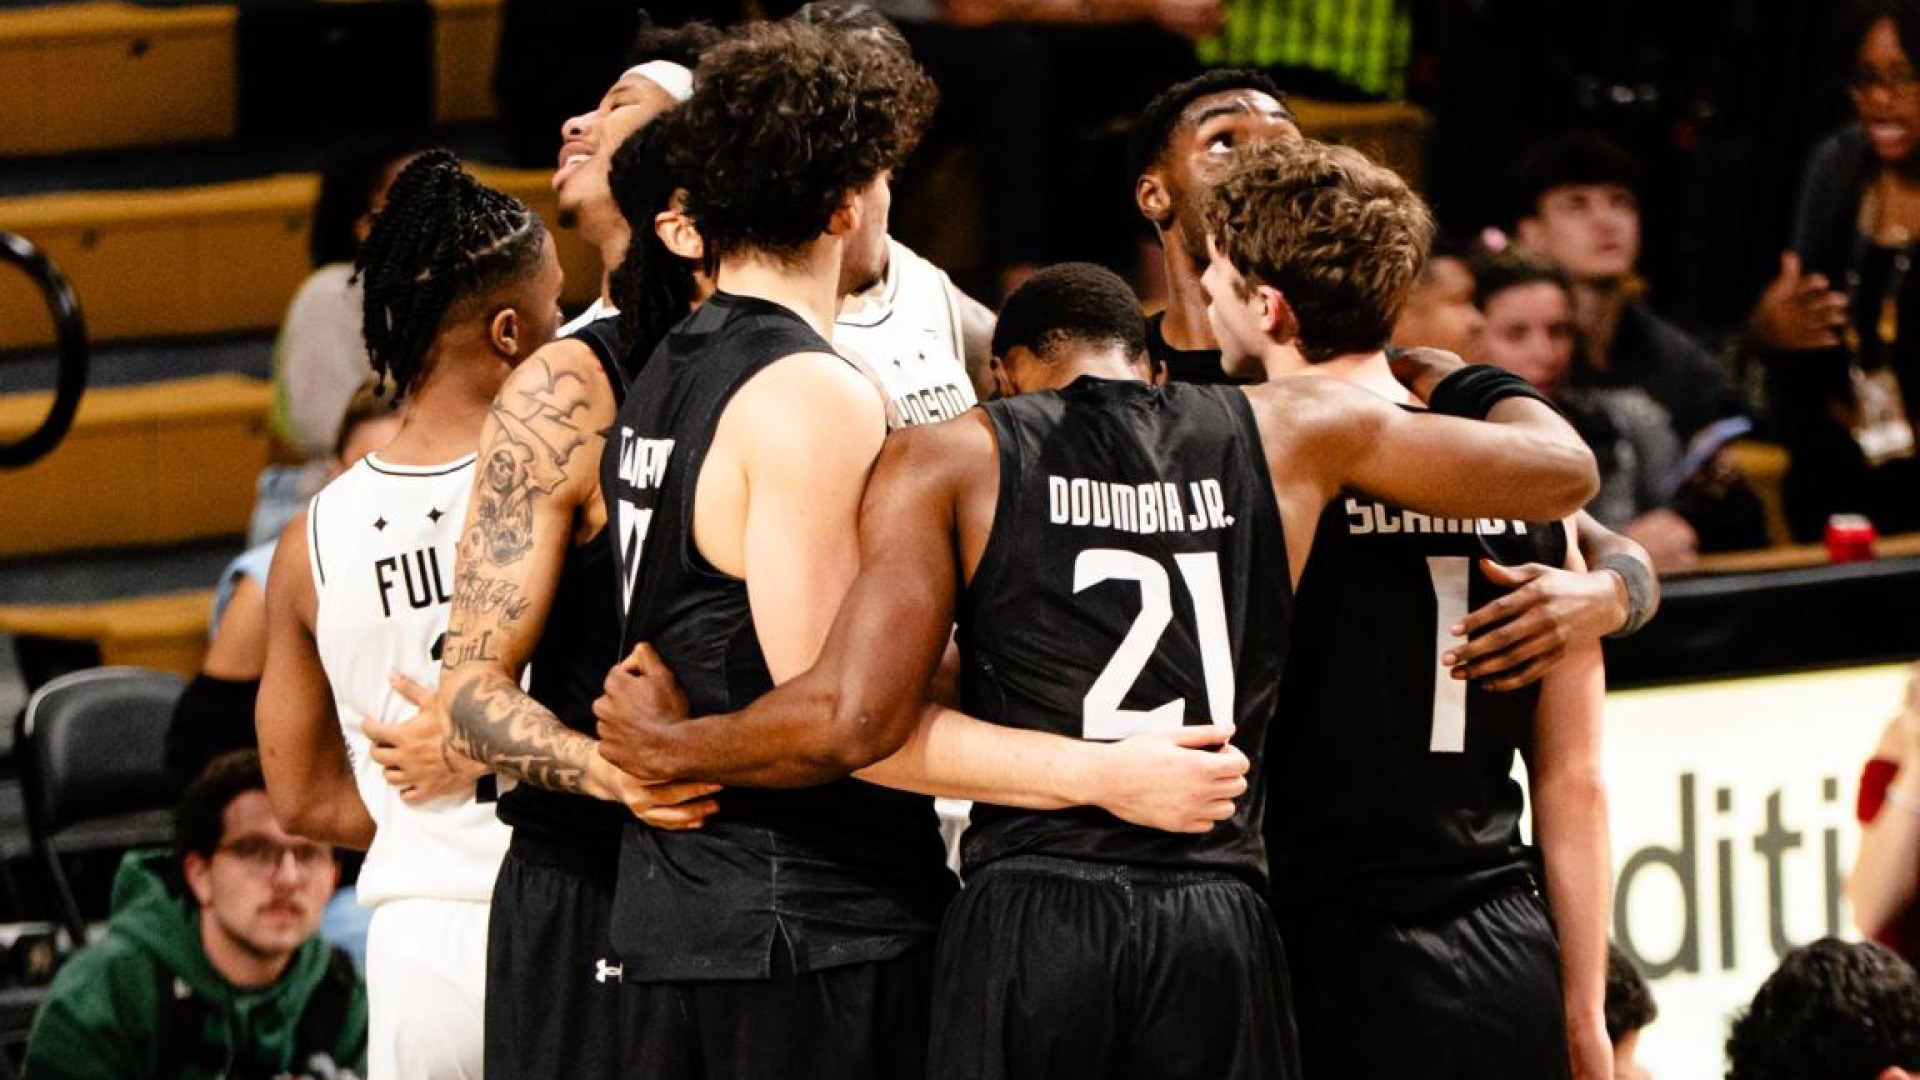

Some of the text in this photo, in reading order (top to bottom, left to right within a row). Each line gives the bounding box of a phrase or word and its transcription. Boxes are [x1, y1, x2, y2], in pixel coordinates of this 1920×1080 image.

[375, 547, 452, 618] FUL
[1049, 475, 1236, 534] DOUMBIA JR.
[1073, 548, 1236, 740] 21
[1425, 556, 1470, 753] 1
[1613, 772, 1840, 981] diti
